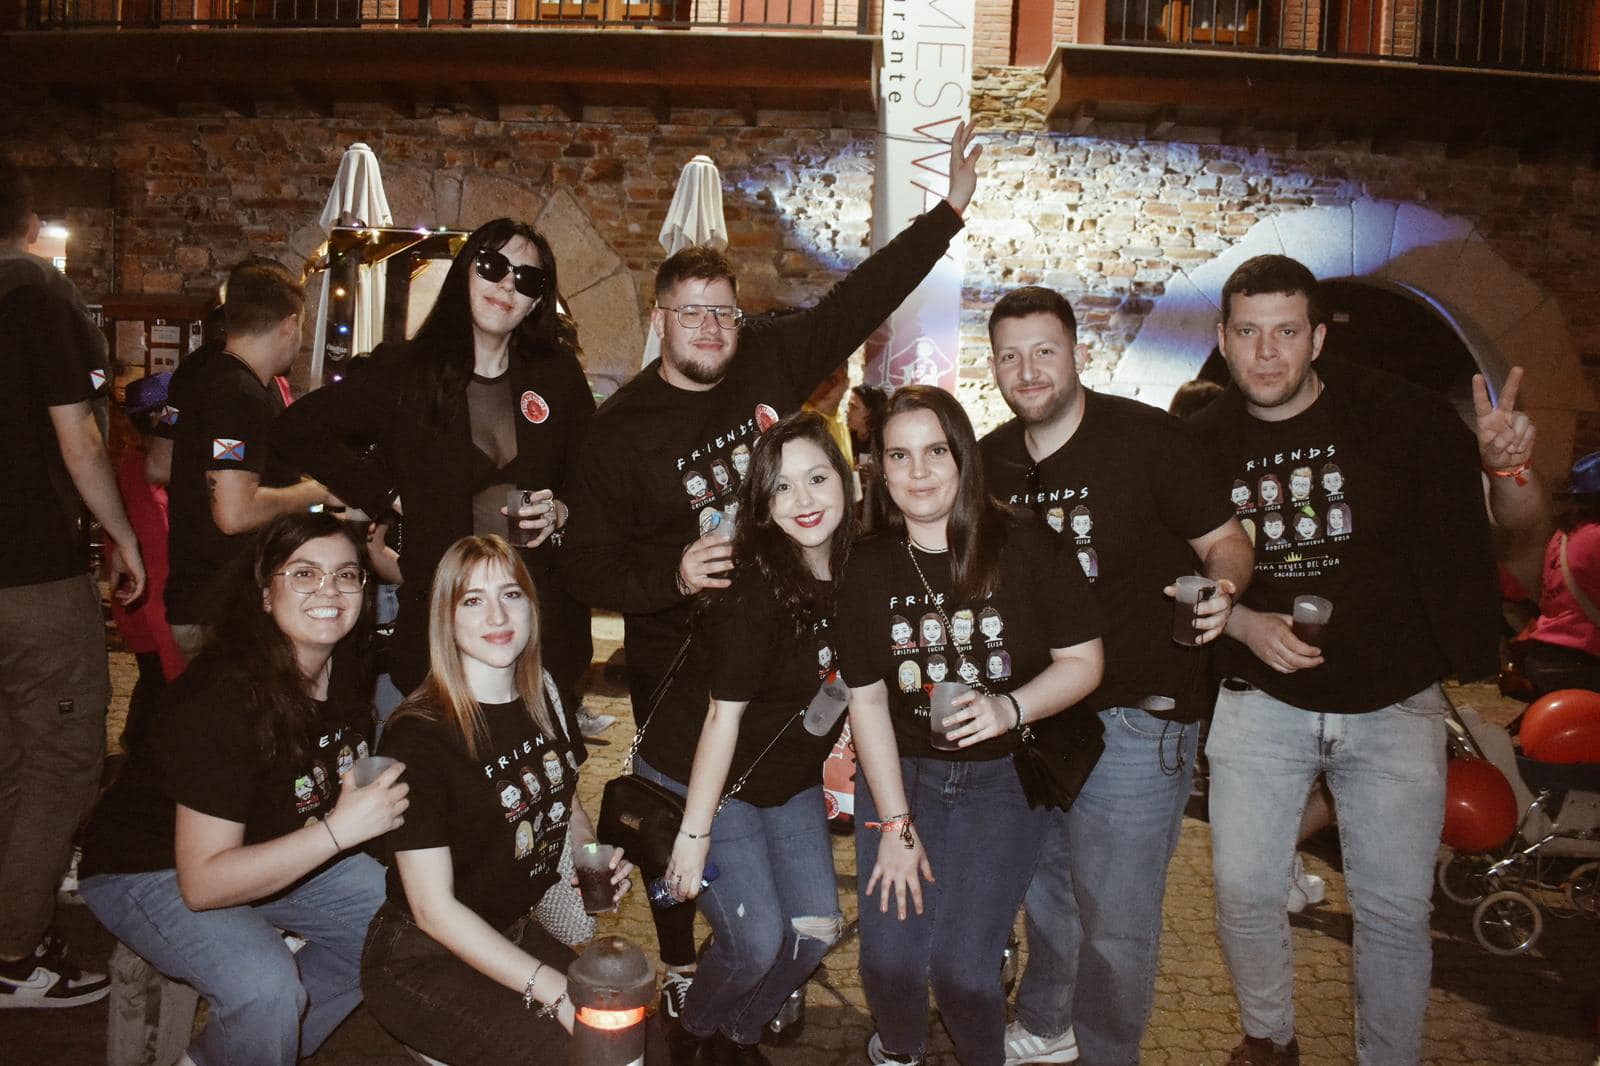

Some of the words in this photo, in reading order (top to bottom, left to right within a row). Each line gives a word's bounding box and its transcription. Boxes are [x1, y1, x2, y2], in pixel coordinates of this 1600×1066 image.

[1246, 444, 1336, 472] RIENDS
[1009, 486, 1089, 504] RIENDS
[484, 732, 545, 779] FRIEN
